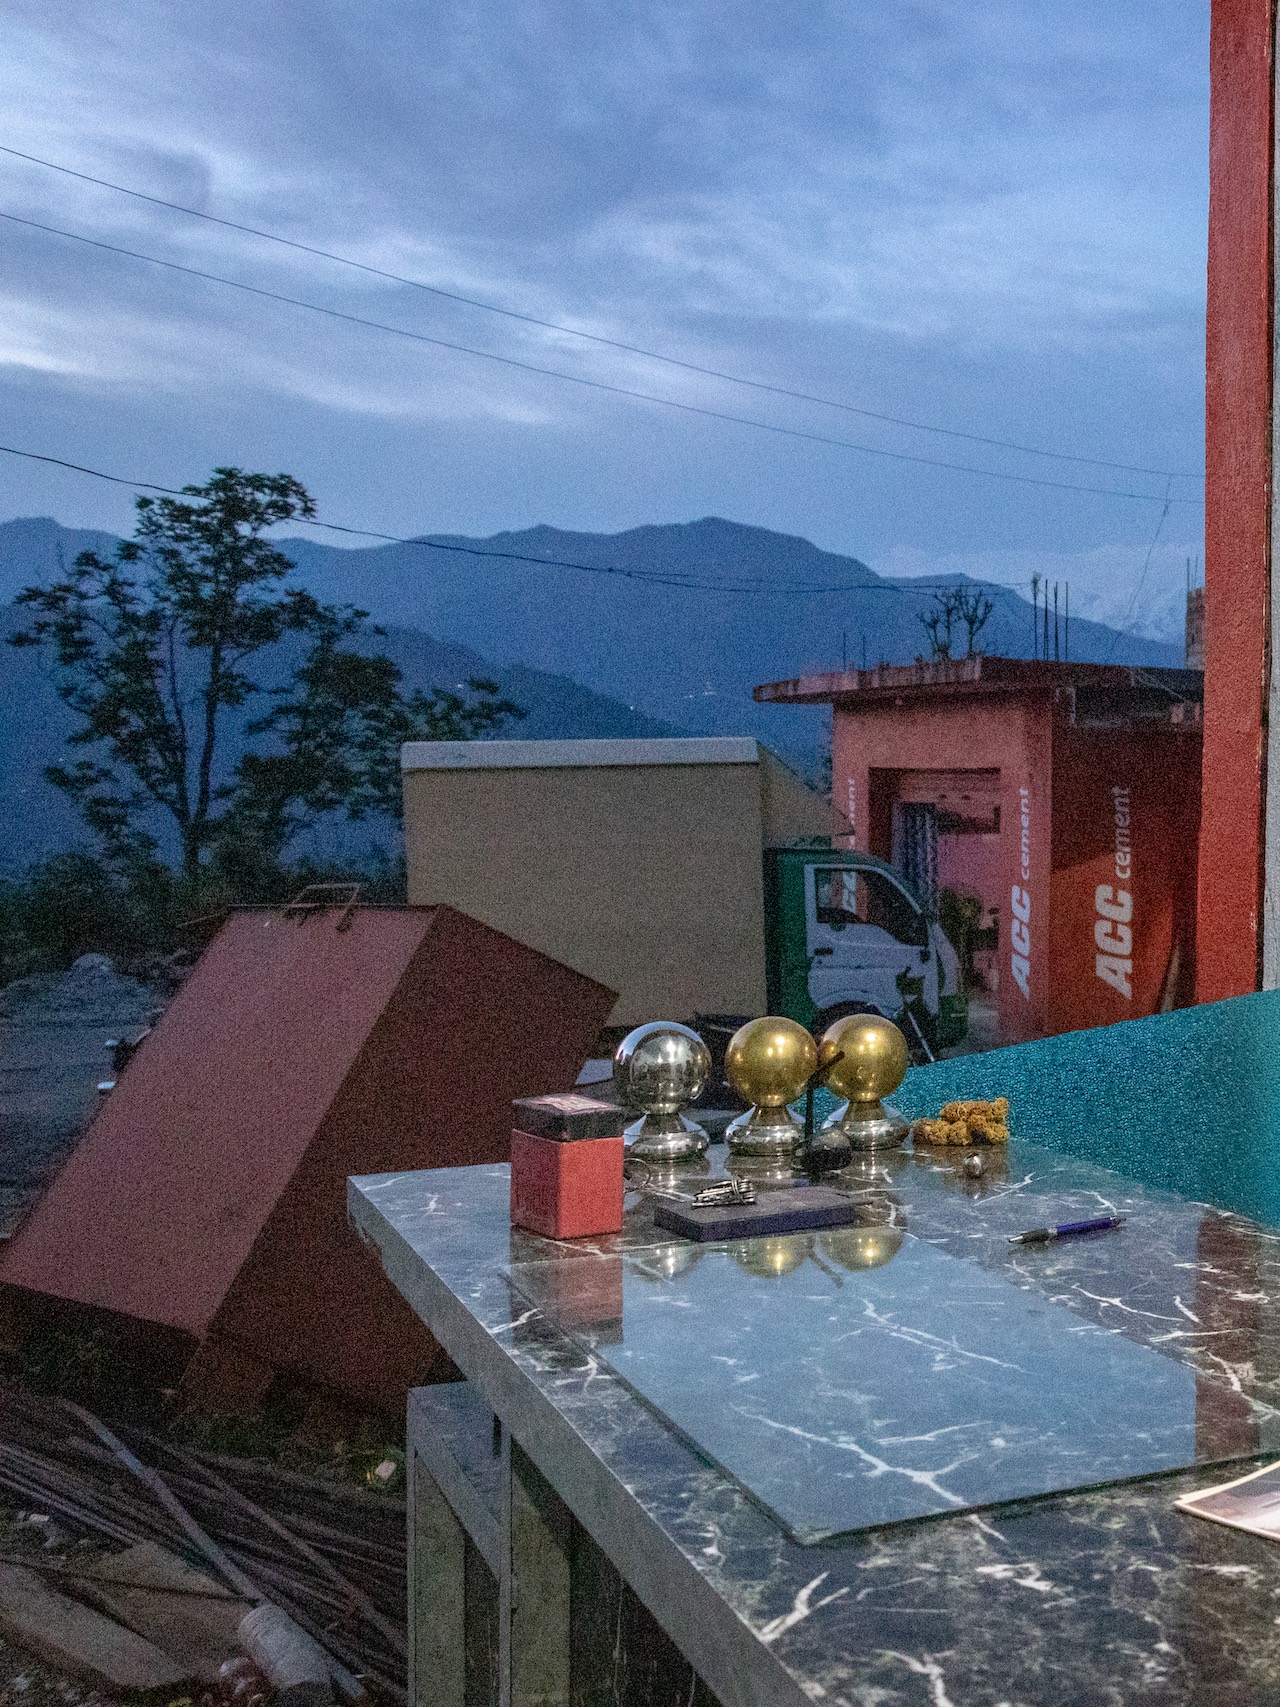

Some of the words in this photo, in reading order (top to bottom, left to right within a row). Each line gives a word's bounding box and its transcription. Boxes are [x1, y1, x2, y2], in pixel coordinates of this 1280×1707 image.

[1018, 787, 1030, 880] cement
[1111, 785, 1131, 880] cement
[1011, 884, 1031, 1000] ACC
[1094, 883, 1134, 1000] ACC
